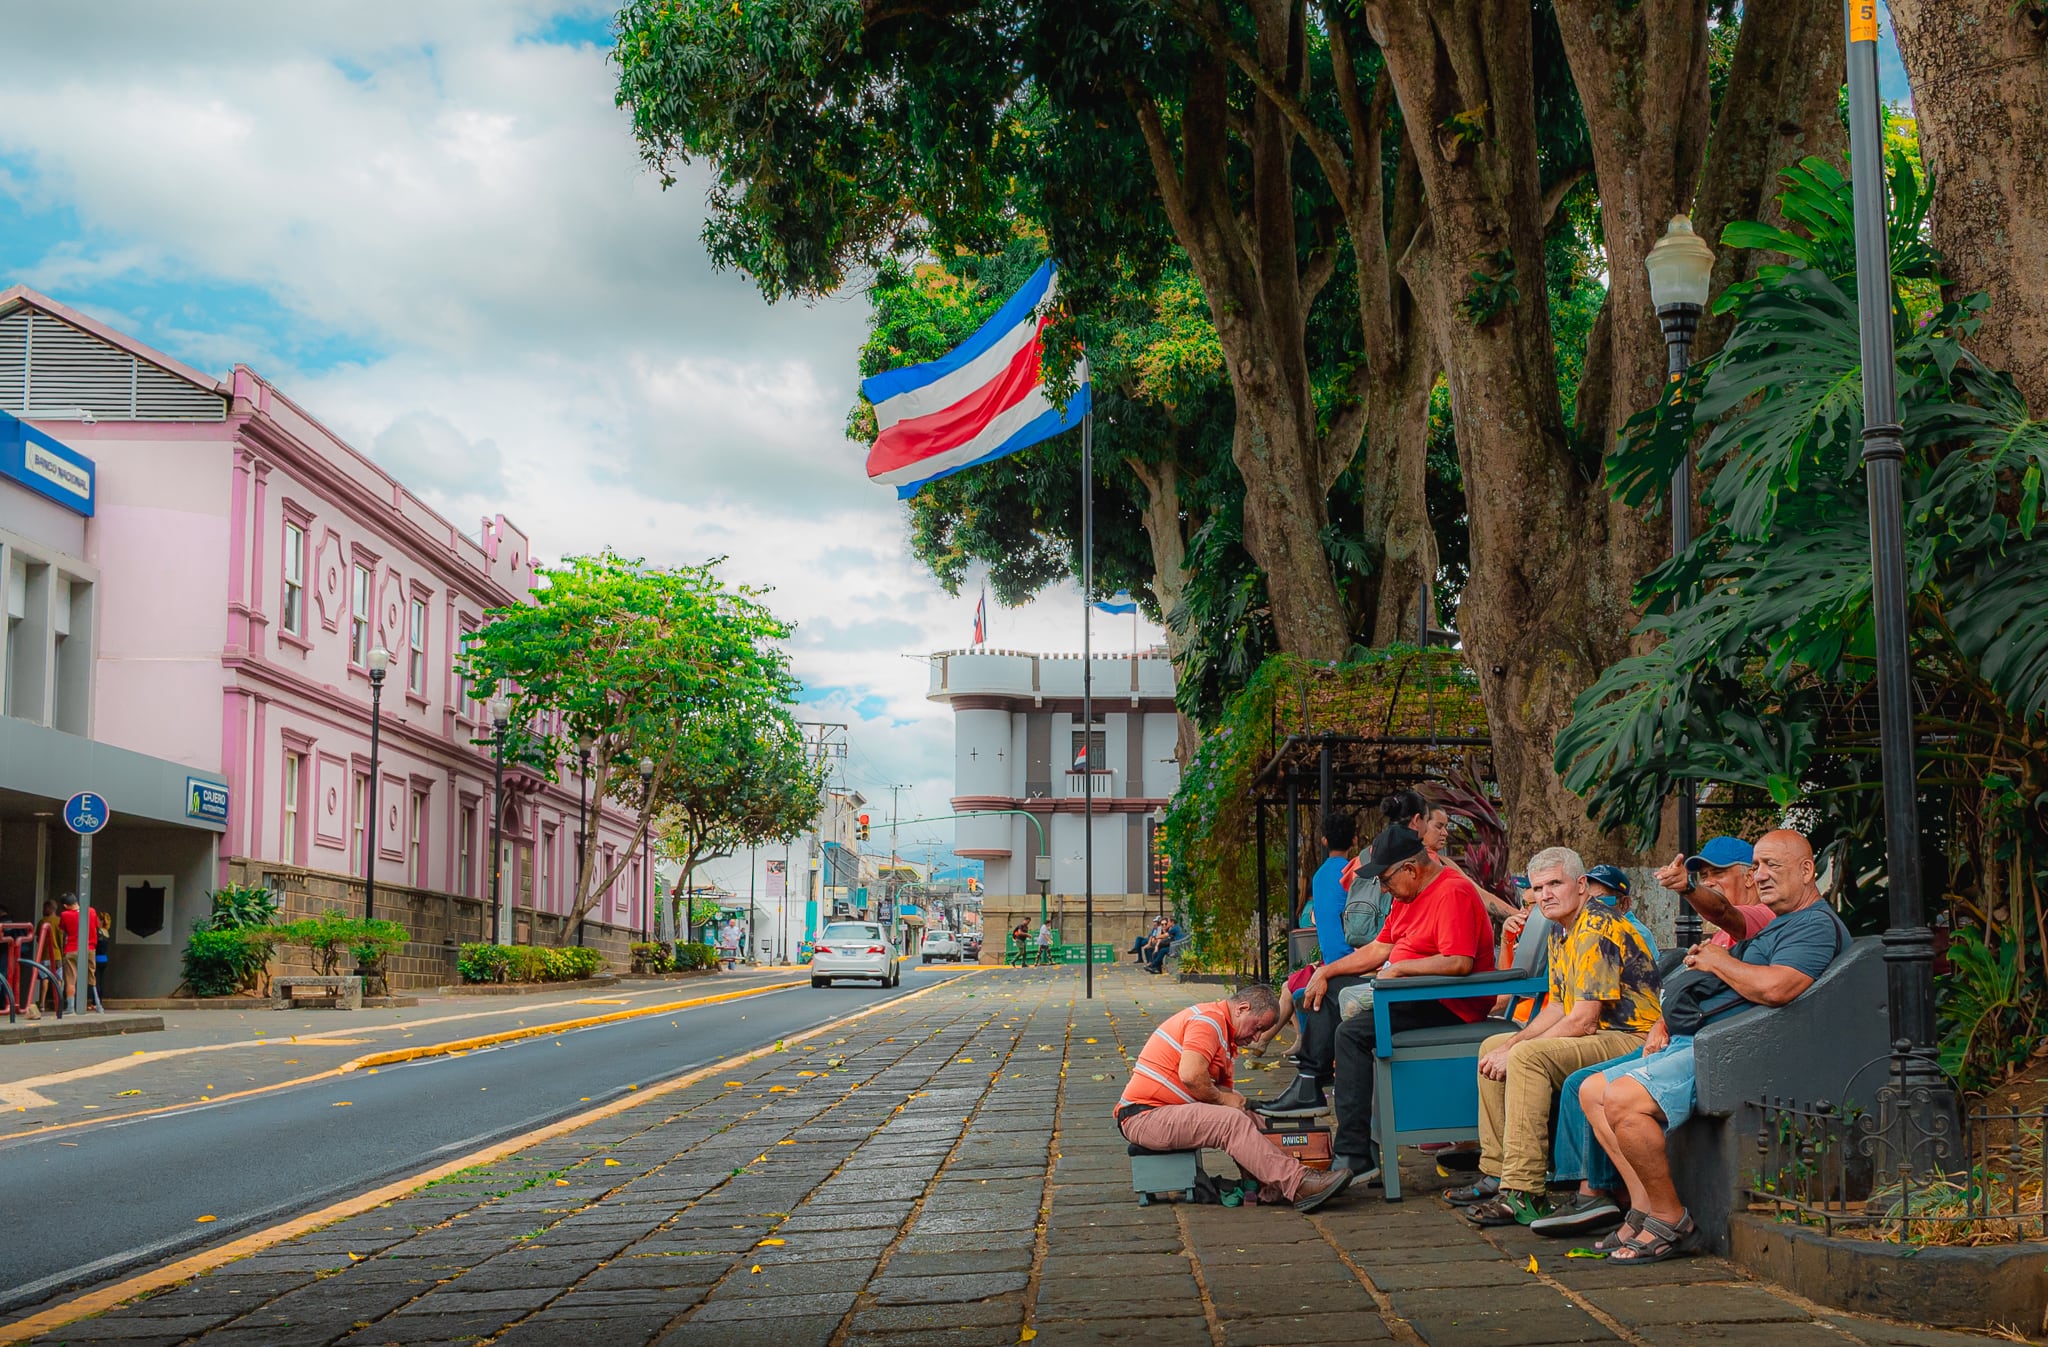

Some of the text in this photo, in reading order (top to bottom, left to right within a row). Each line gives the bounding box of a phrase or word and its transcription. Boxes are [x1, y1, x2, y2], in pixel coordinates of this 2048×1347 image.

[1861, 6, 1873, 20] 5
[35, 454, 88, 491] BANCO NACIONAL
[81, 795, 92, 811] E
[203, 790, 225, 805] CAJERO
